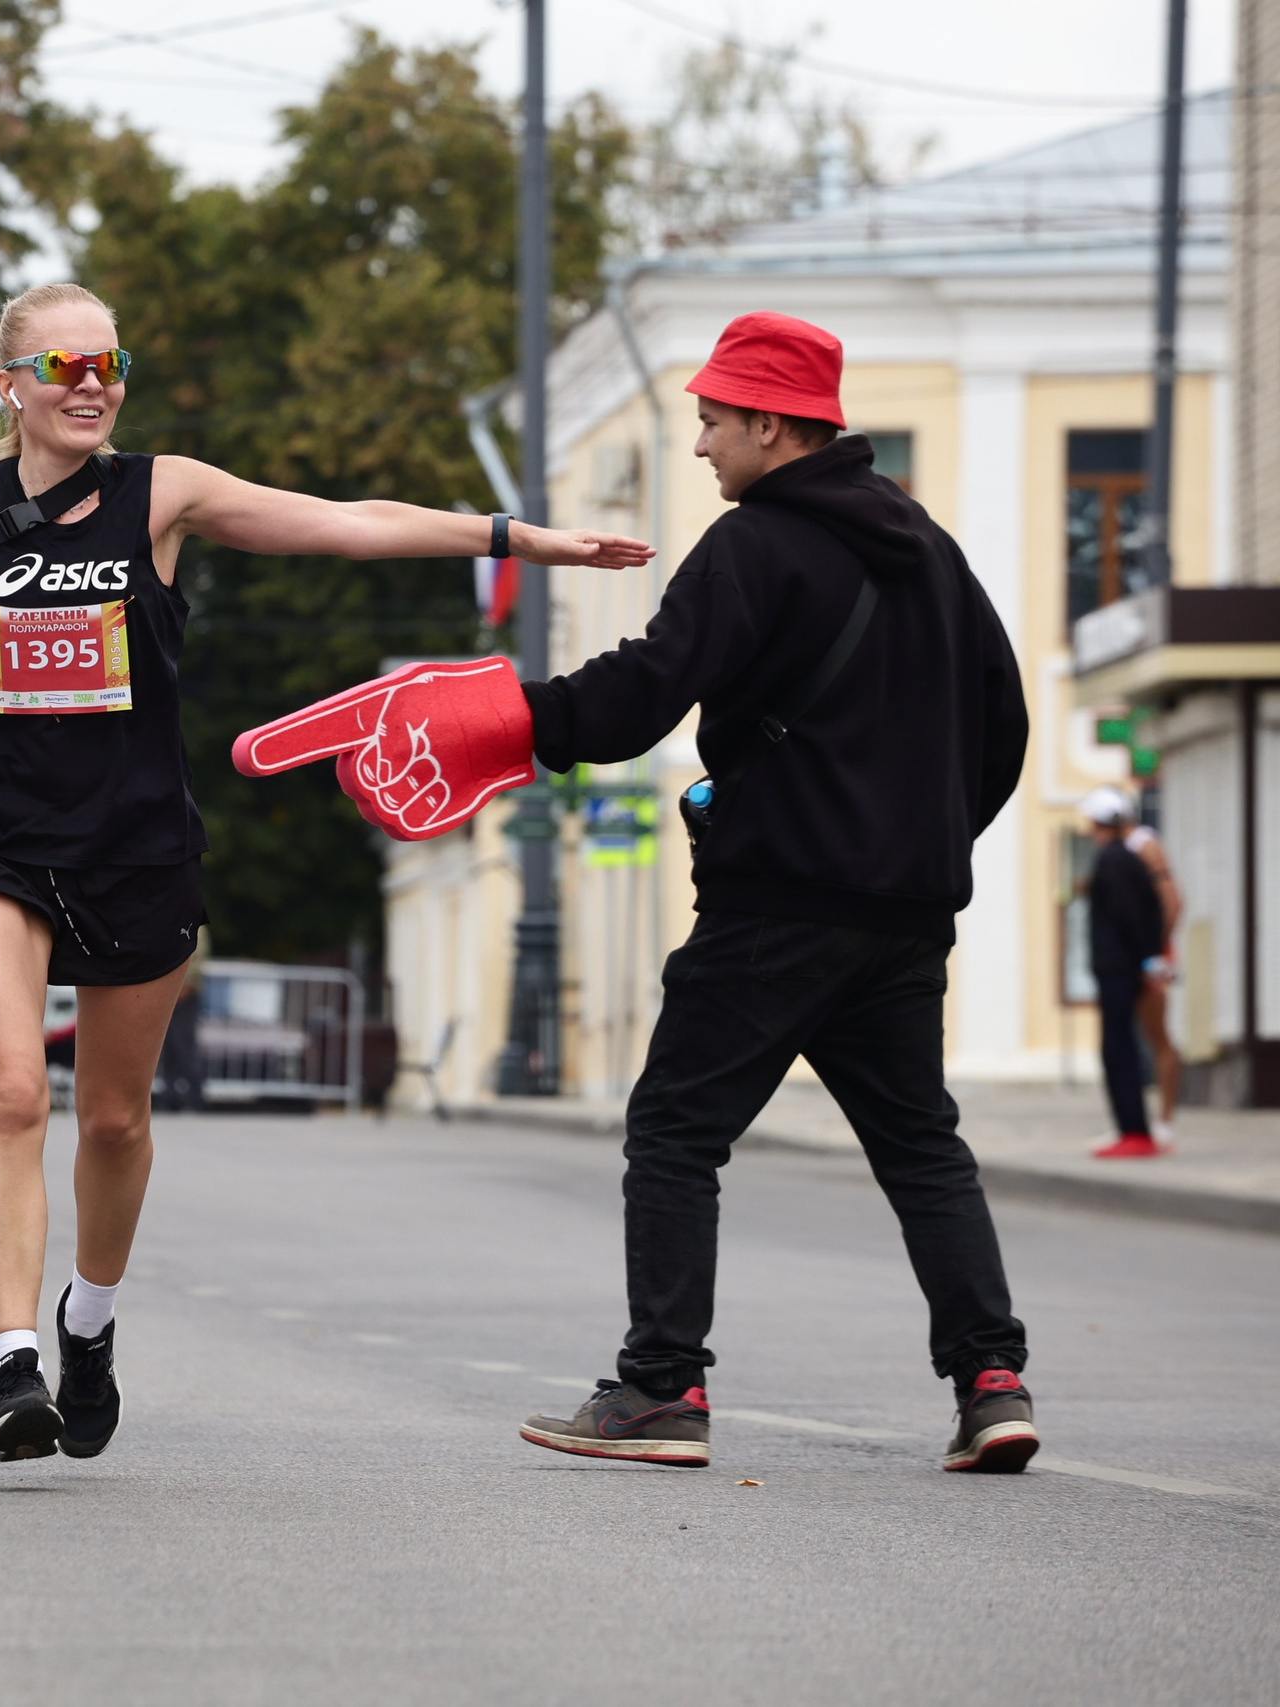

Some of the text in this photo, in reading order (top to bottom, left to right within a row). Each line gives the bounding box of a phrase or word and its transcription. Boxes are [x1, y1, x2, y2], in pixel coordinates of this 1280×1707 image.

[39, 560, 129, 591] asics
[8, 607, 88, 622] ЕЛЕЦКИЙ
[9, 622, 89, 634] ПОЛУМАРАФОН
[4, 638, 100, 670] 1395
[110, 646, 122, 671] 10,5
[100, 692, 126, 700] FORTUNA
